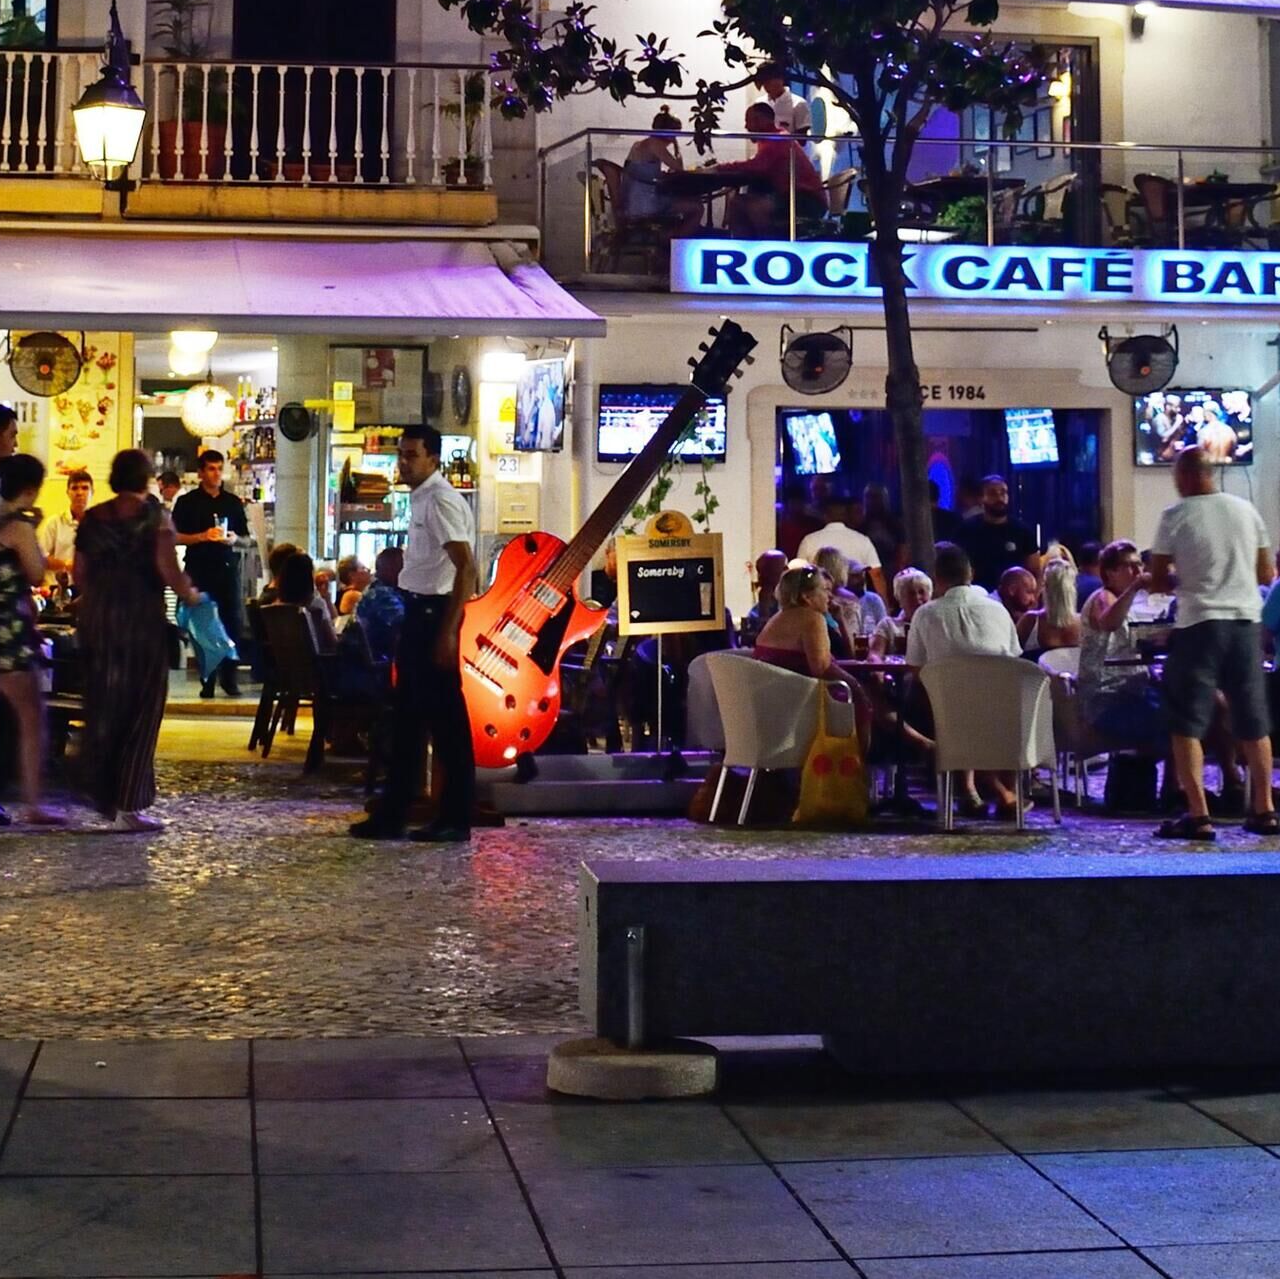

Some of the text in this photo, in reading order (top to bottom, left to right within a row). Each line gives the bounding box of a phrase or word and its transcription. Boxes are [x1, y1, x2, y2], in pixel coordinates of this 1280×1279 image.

[942, 251, 1136, 294] CAFÉ
[948, 385, 986, 400] 1984
[648, 538, 692, 549] SOMERSBY
[637, 566, 685, 579] Somersby
